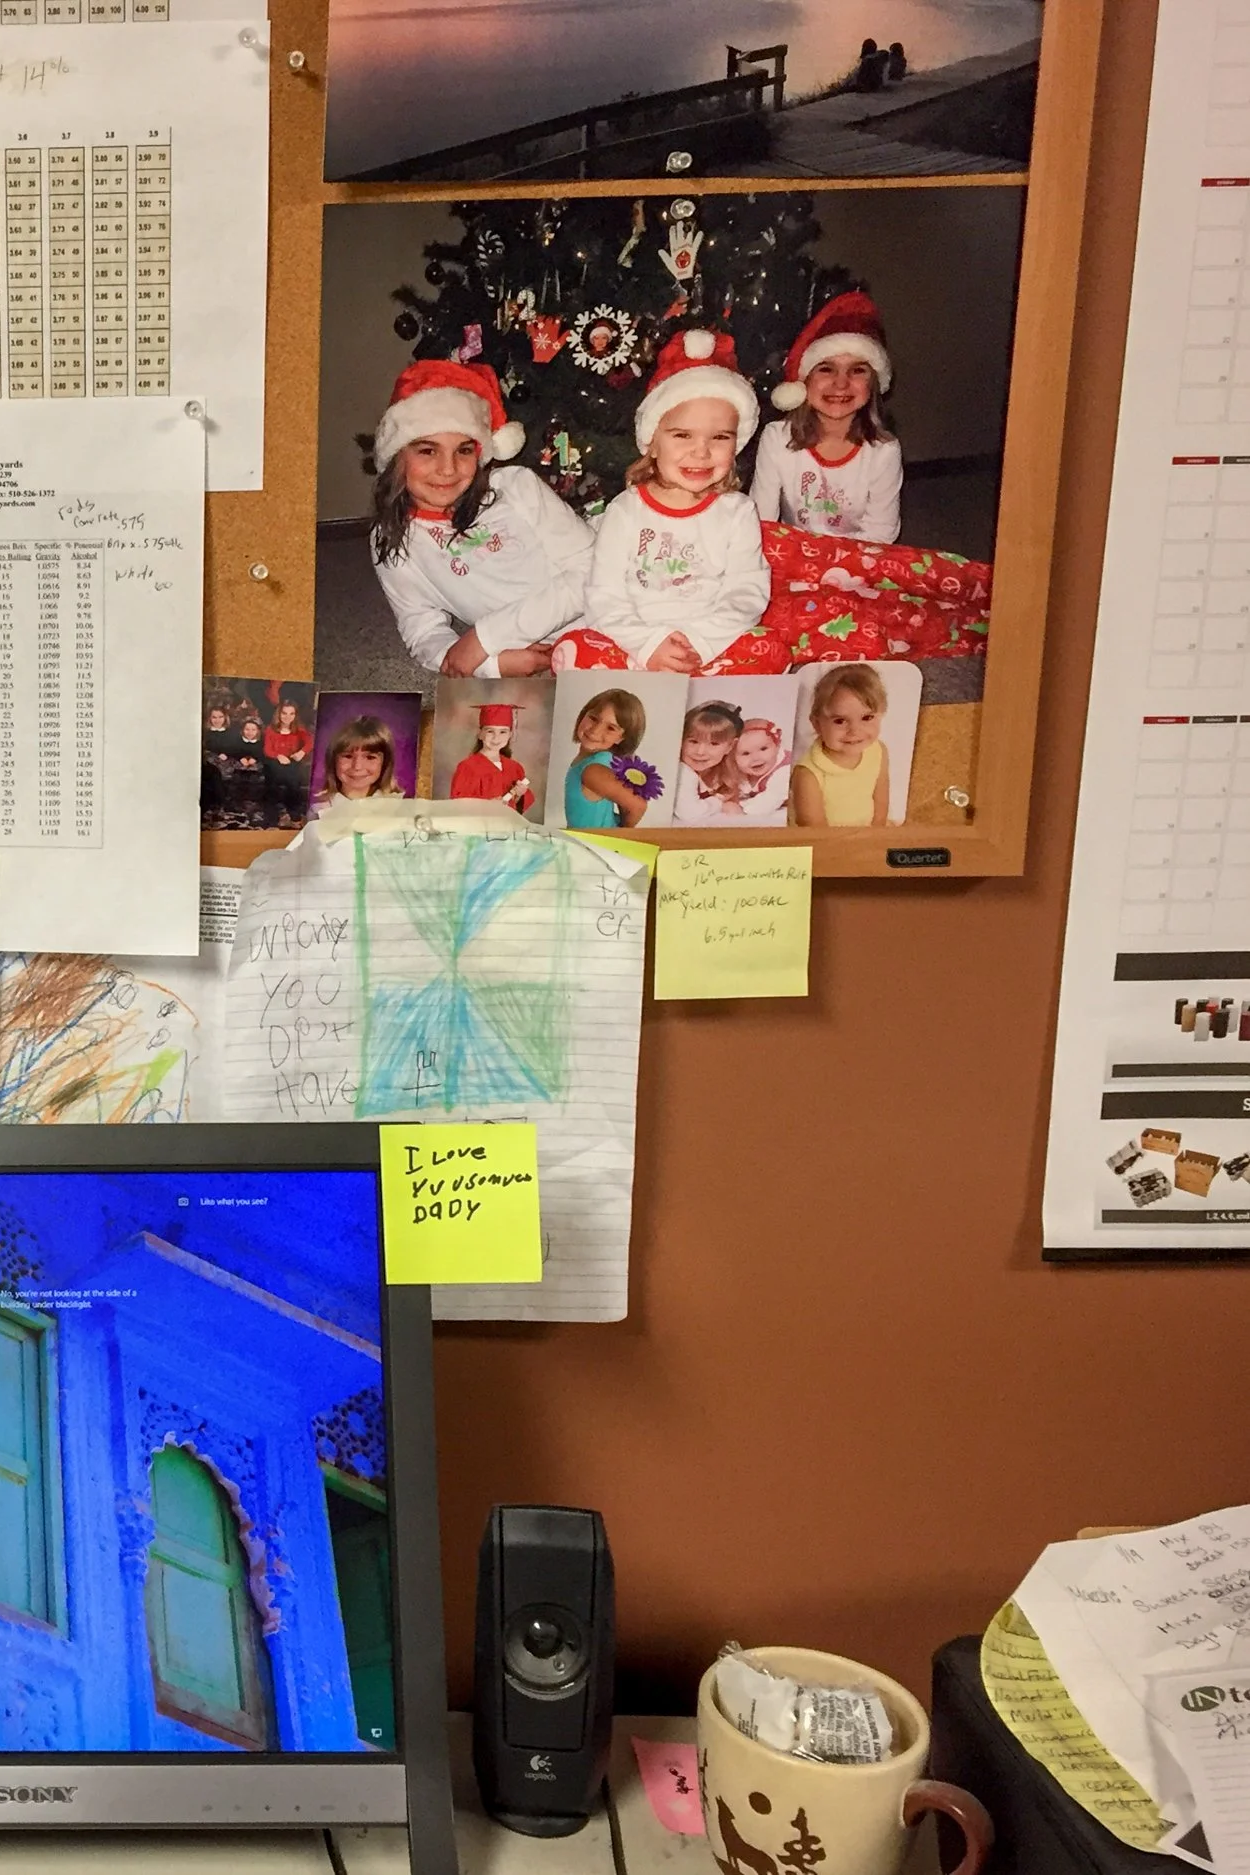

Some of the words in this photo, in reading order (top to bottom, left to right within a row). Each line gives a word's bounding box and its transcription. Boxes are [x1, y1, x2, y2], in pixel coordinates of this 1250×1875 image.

[24, 56, 70, 91] 14%
[404, 1146, 423, 1175] I
[236, 1199, 250, 1207] you
[15, 1290, 38, 1299] you're
[54, 1289, 81, 1299] looking
[92, 1289, 104, 1297] the
[106, 1289, 121, 1297] side
[122, 1289, 131, 1297] of
